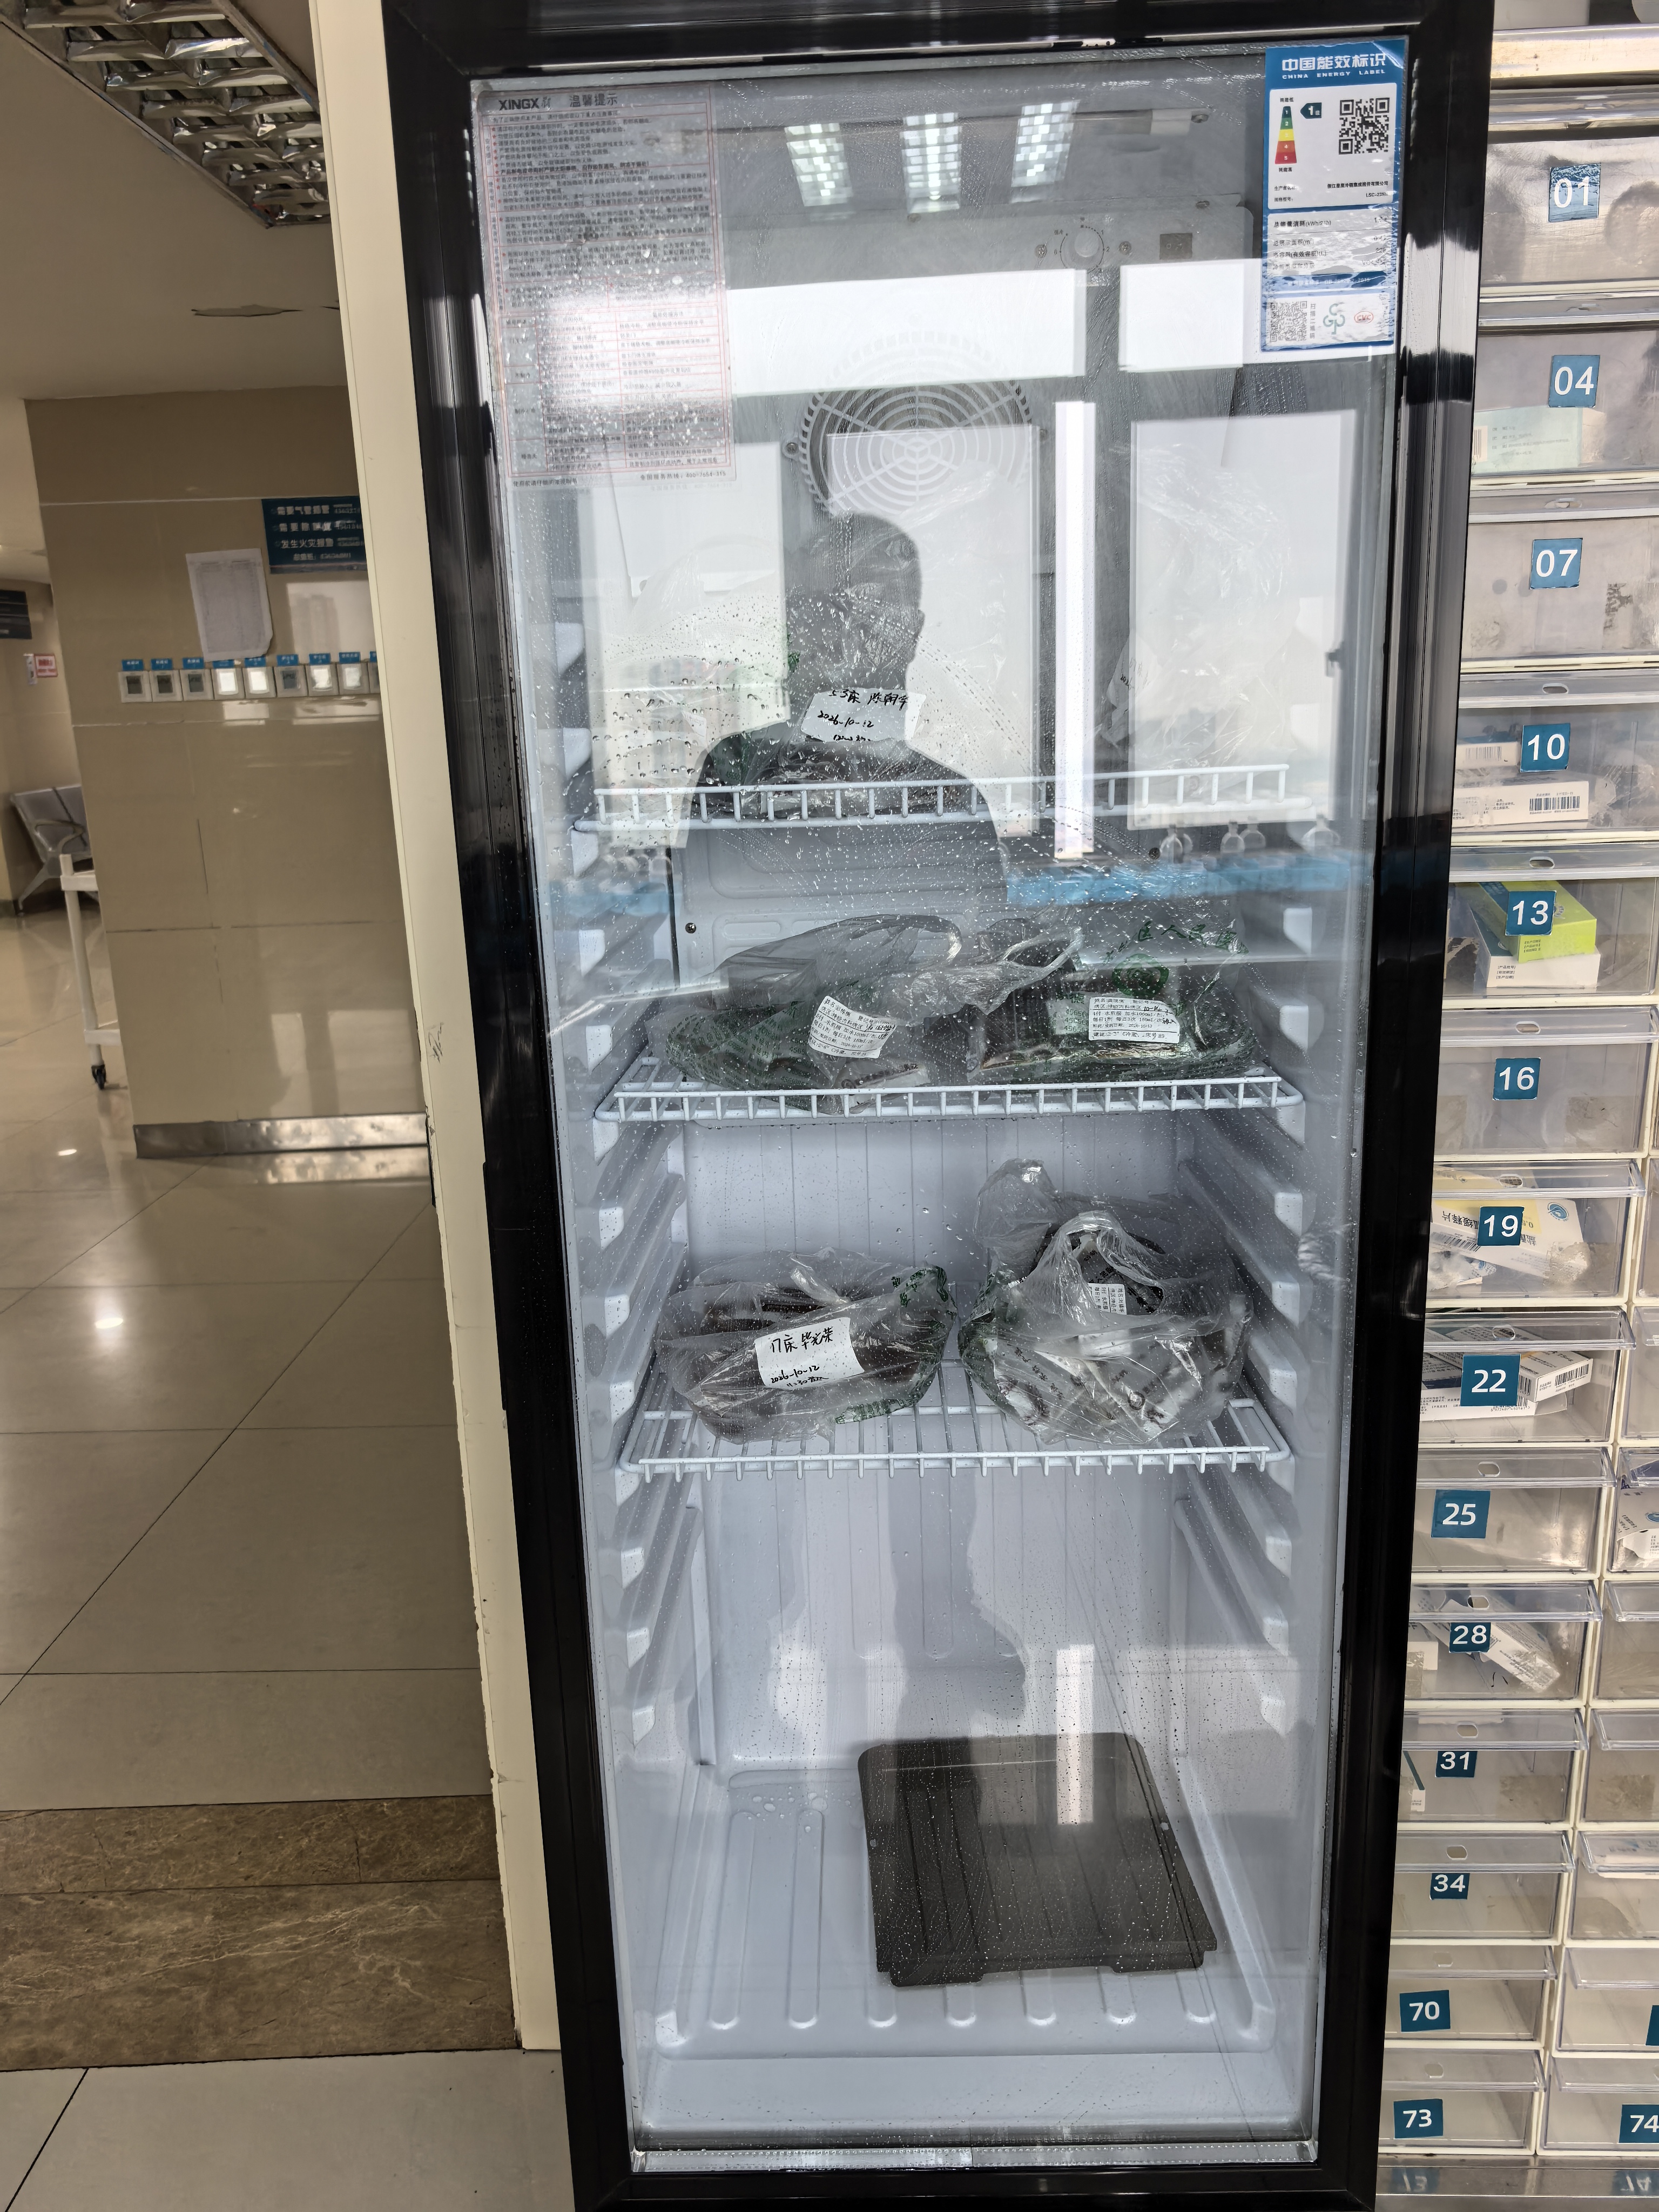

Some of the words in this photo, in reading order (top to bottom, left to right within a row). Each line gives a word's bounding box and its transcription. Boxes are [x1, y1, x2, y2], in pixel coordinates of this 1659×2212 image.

[1282, 53, 1386, 71] 中国能效标识
[498, 98, 539, 111] XINGX
[570, 93, 618, 107] 温馨提示
[1553, 176, 1591, 209] 01
[1554, 366, 1594, 395] 04
[1535, 548, 1578, 578] 07
[817, 710, 874, 728] 2026-10-12
[1527, 733, 1566, 761] 10
[1512, 900, 1549, 926] 13
[1499, 1066, 1535, 1091] 16
[1484, 1215, 1519, 1237] 19
[770, 1365, 820, 1384] 2026-10-12
[1471, 1369, 1506, 1393] 22
[1442, 1503, 1477, 1526] 25
[1453, 1624, 1487, 1644] 28
[1439, 1751, 1471, 1771] 31
[1433, 1874, 1466, 1893] 34
[1409, 2001, 1440, 2021] 70
[1403, 2109, 1432, 2128] 73
[1630, 2115, 1659, 2133] 74
